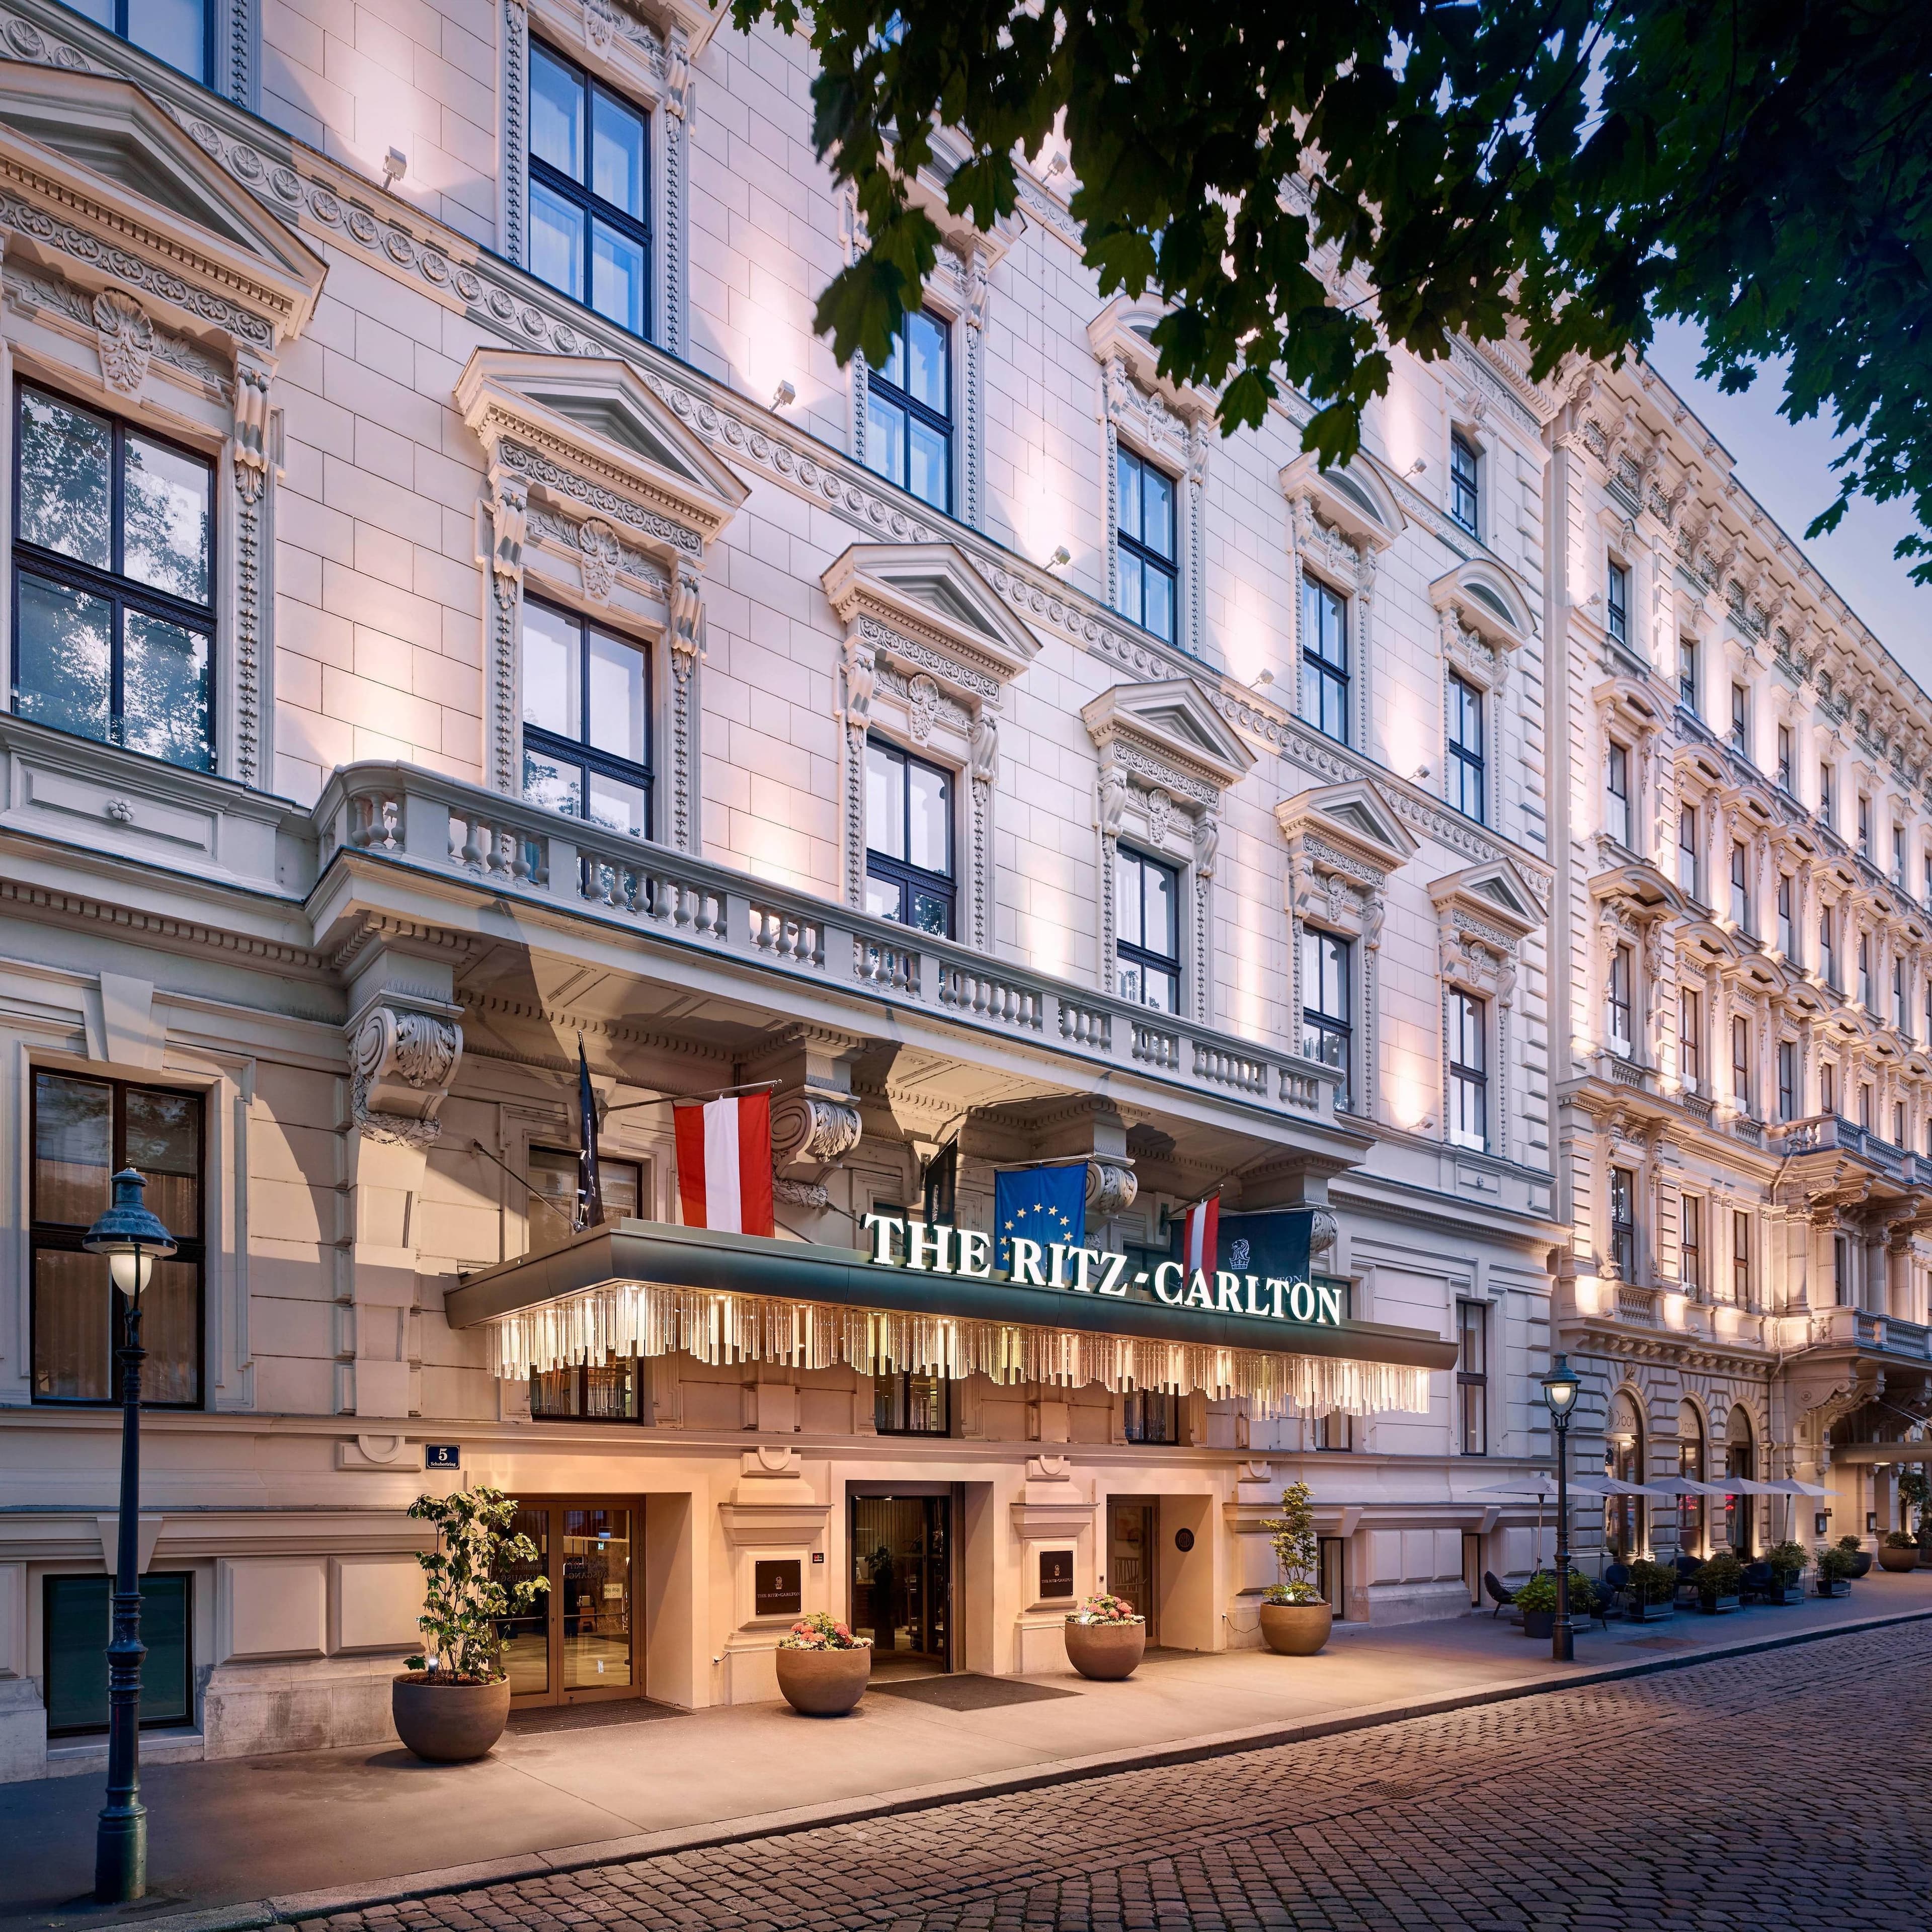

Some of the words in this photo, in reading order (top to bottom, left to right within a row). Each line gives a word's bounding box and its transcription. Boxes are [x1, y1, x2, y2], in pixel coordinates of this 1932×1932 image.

[861, 1213, 991, 1278] THE
[1007, 1237, 1342, 1326] RITZ-CARLTON
[439, 1448, 447, 1461] 5
